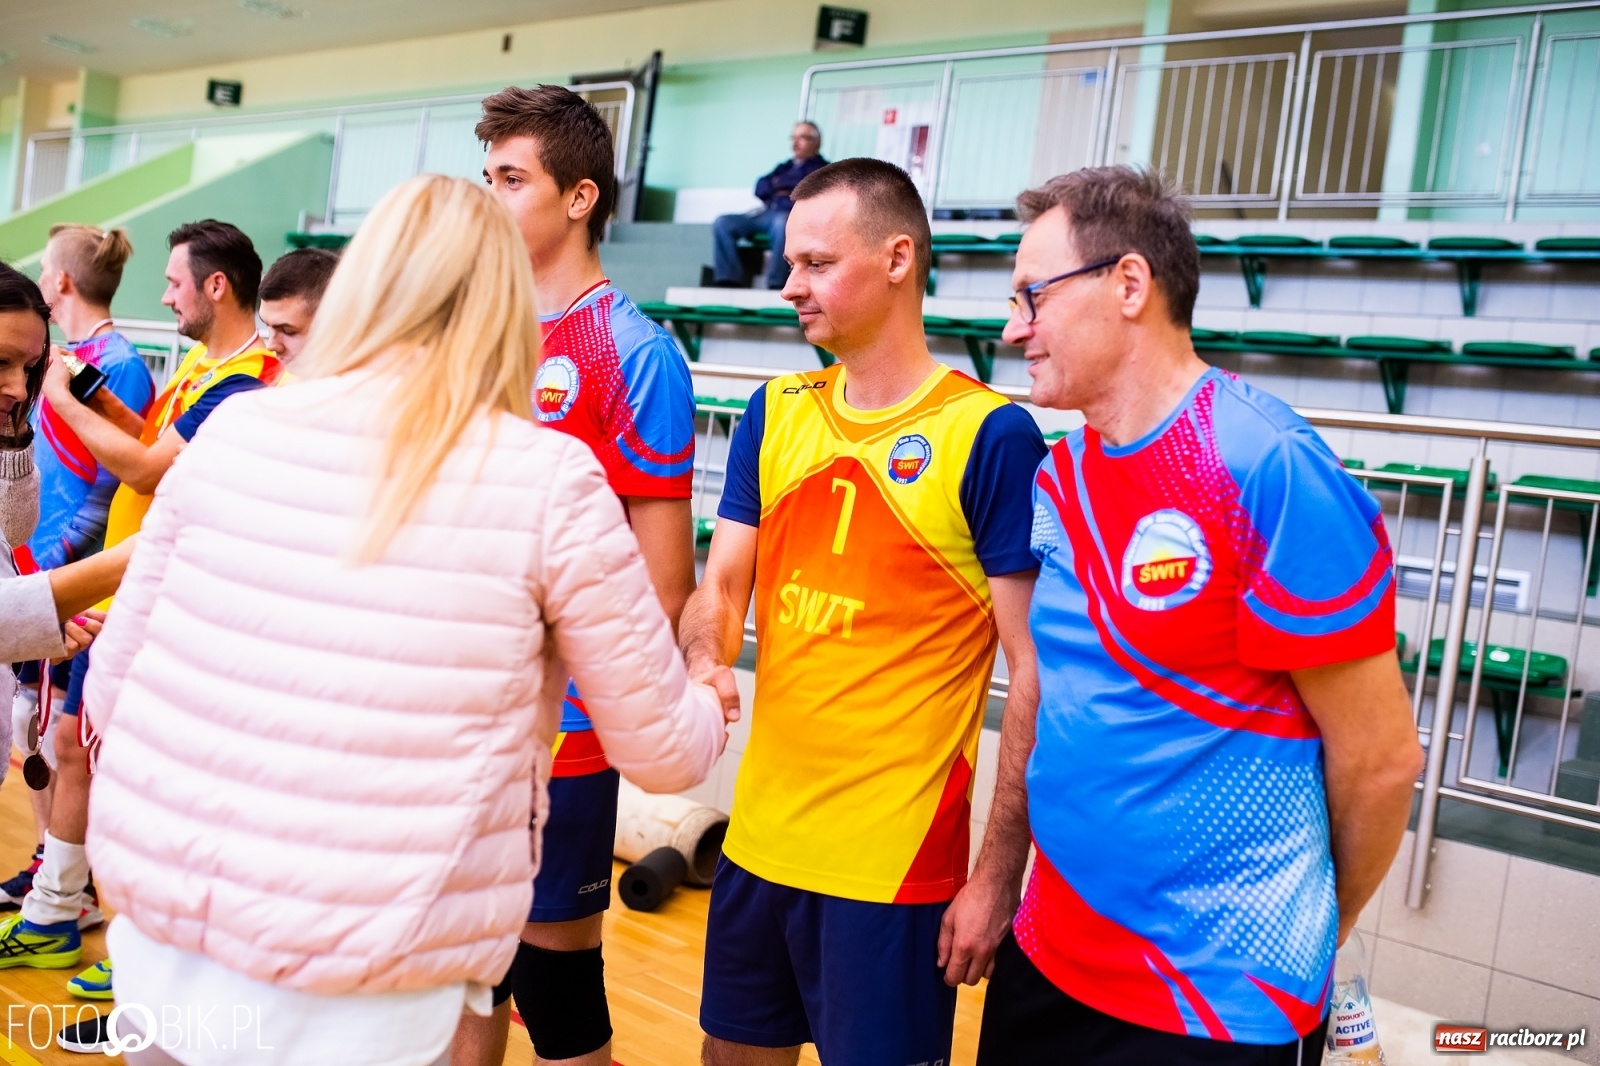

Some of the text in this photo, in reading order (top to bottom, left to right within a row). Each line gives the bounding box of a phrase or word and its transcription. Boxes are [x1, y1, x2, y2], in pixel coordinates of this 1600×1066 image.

[830, 18, 856, 39] F
[831, 477, 857, 555] 7
[1139, 560, 1189, 583] ŚWIT
[778, 569, 865, 639] ŚWIT
[577, 879, 609, 894] COLO
[1335, 1020, 1371, 1035] ACTIVE
